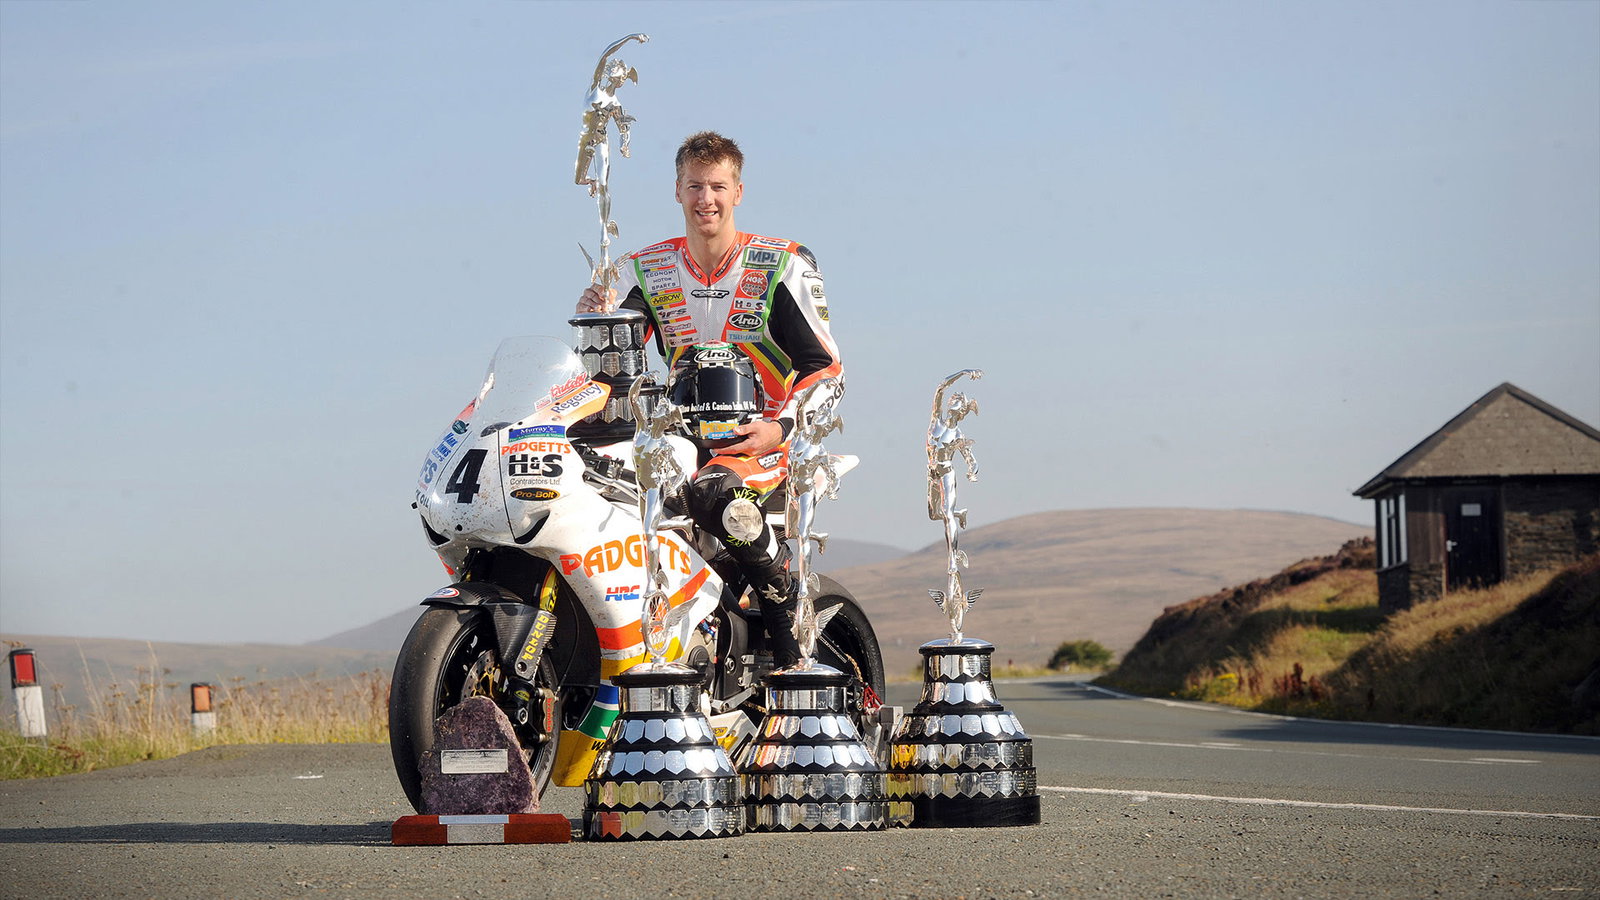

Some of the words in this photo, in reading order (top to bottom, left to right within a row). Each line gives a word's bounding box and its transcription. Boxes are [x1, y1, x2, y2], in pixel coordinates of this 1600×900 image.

[748, 250, 777, 263] MPL
[646, 270, 676, 278] ECONOMY
[732, 313, 759, 325] Arai
[699, 350, 730, 360] Arai
[551, 383, 602, 414] Regency
[712, 401, 733, 411] Casino
[520, 425, 554, 434] Murray's
[501, 441, 571, 456] PADGETTS
[508, 453, 564, 478] H&S
[445, 448, 488, 504] 4
[510, 478, 548, 486] Contractors
[559, 534, 692, 578] PADGTS
[605, 585, 640, 602] HRC
[521, 614, 550, 661] DUNLOP
